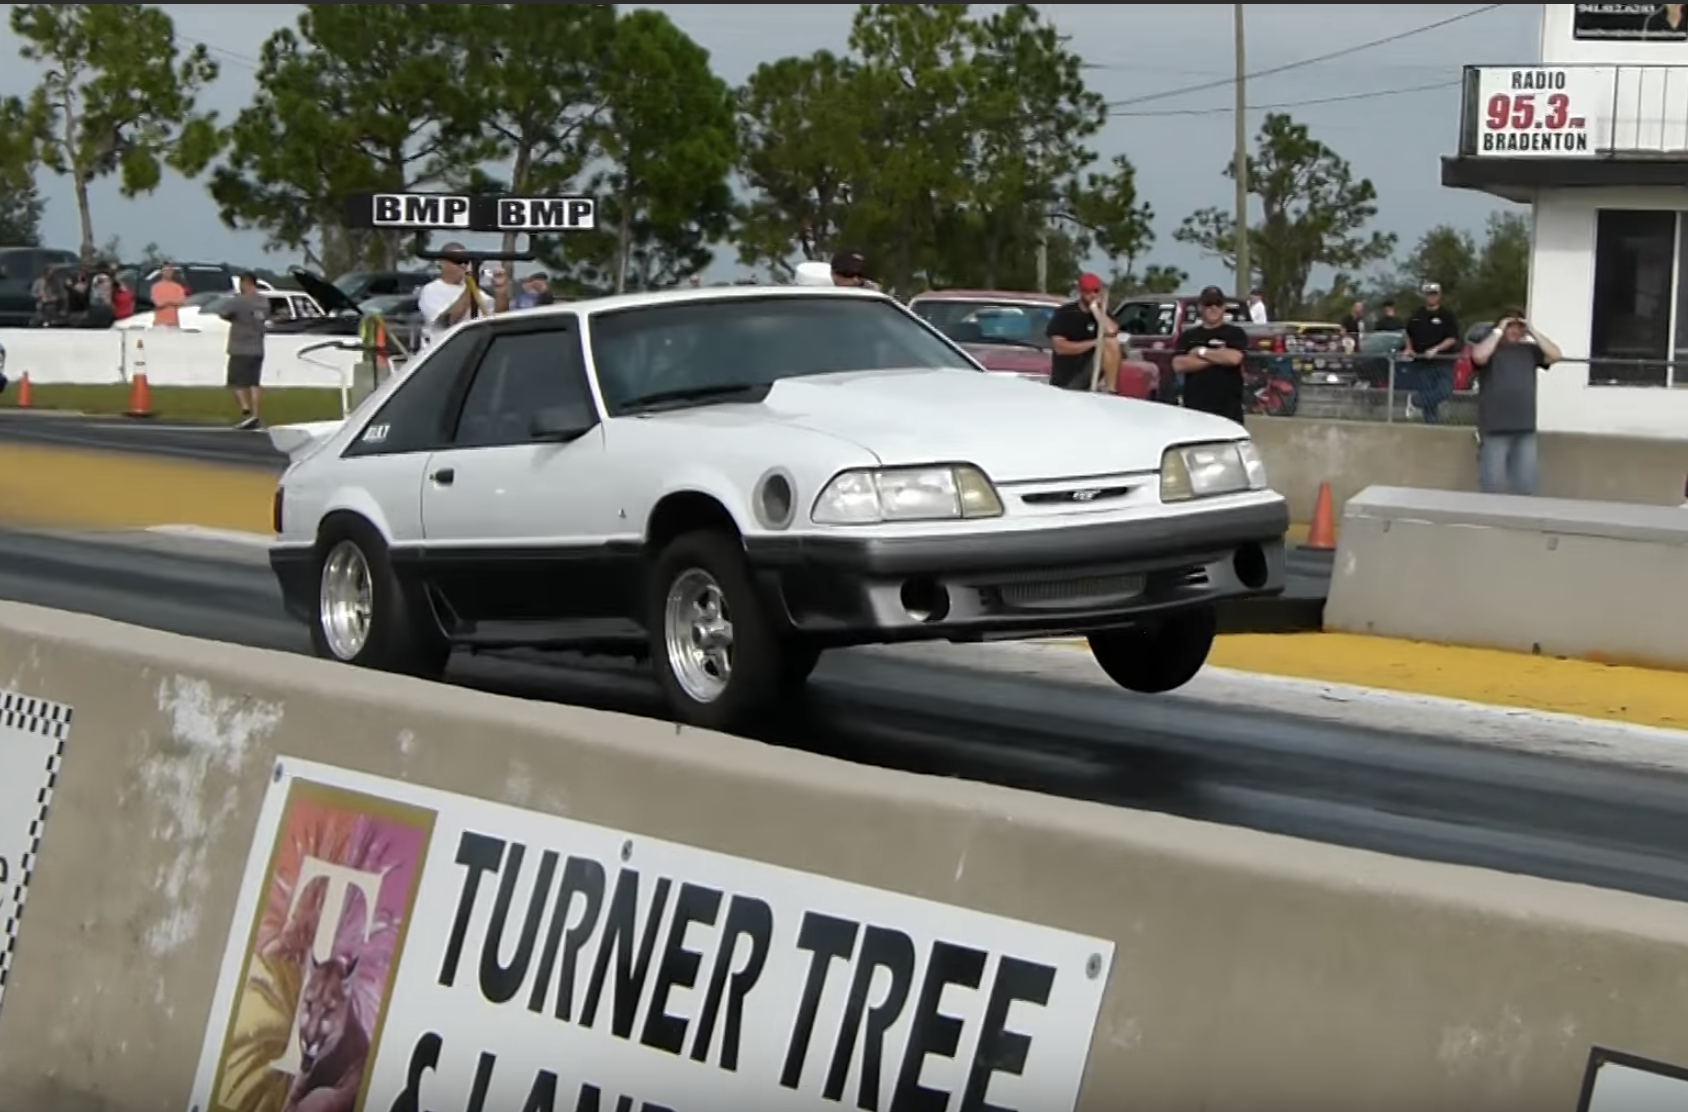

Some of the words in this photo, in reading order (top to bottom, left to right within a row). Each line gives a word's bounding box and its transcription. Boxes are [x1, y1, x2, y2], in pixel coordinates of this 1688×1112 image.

[1511, 71, 1566, 89] RADIO
[1486, 93, 1569, 130] 95.3
[1483, 133, 1587, 151] BRADENTON
[376, 197, 467, 223] BMP
[502, 200, 591, 226] BMP
[437, 830, 774, 1072] TURNER
[779, 910, 1057, 1112] TREE
